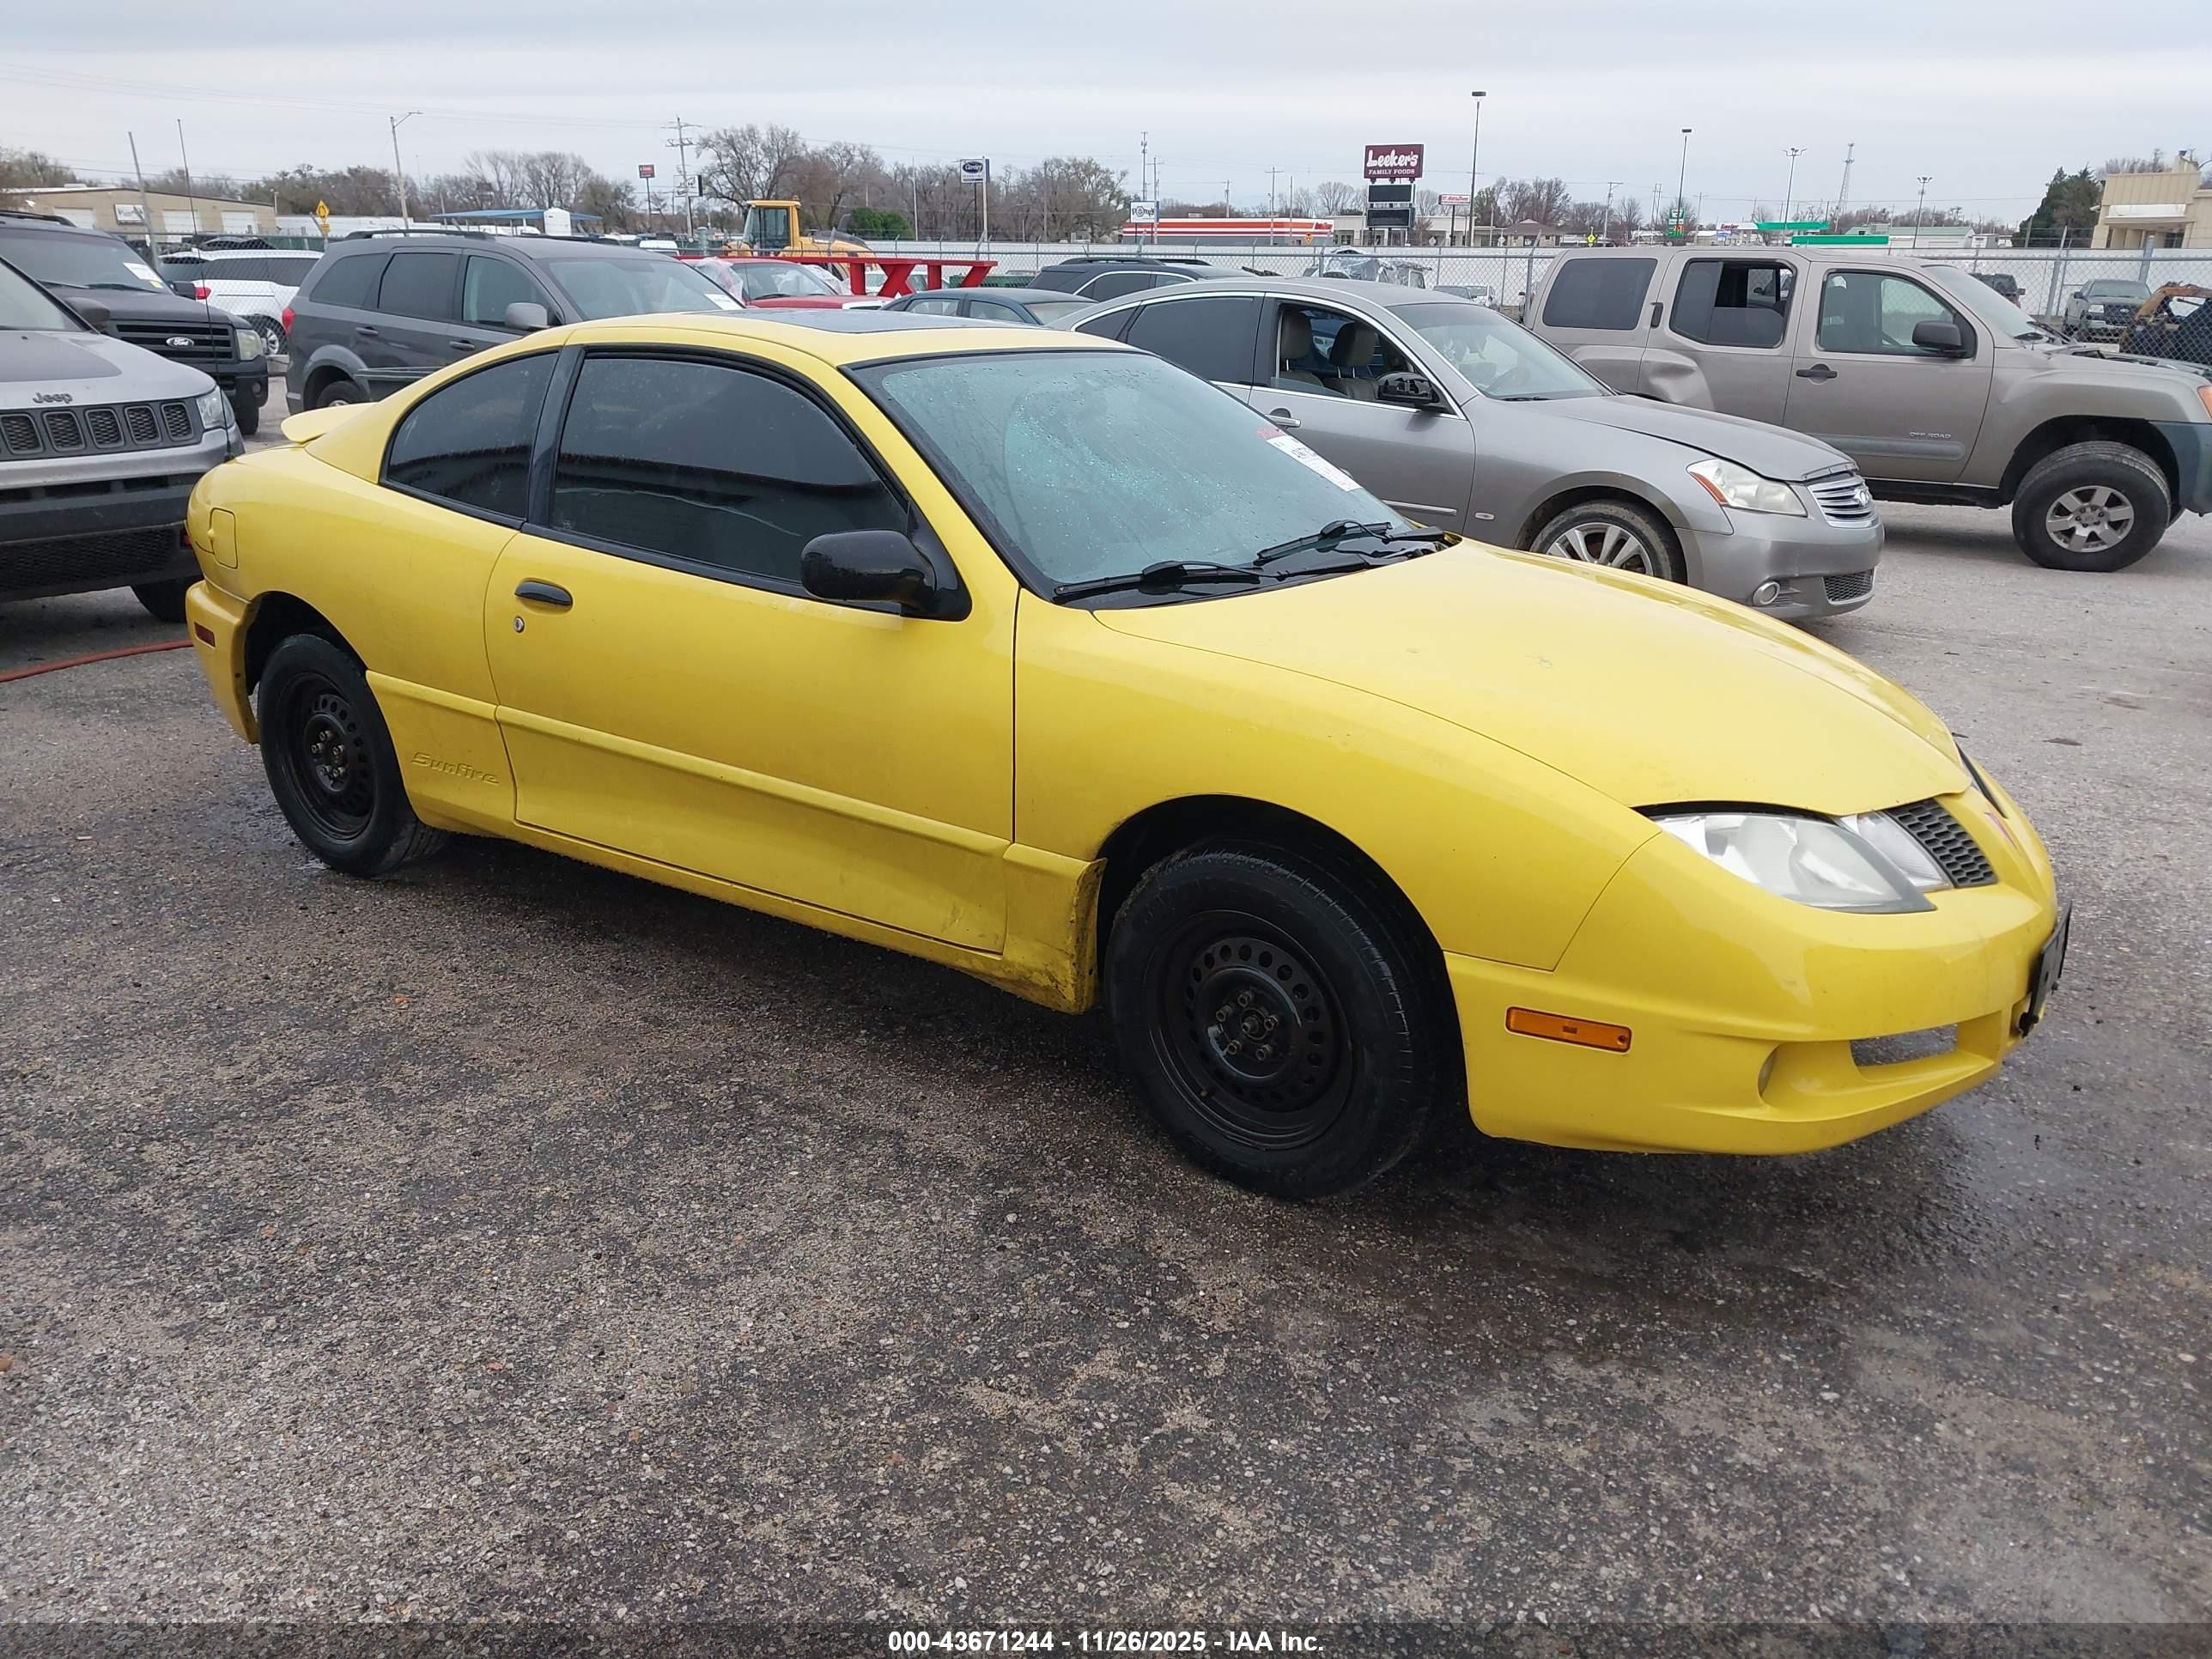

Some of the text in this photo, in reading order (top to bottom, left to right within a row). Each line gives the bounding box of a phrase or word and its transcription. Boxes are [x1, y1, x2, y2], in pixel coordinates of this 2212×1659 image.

[1366, 149, 1419, 167] Leeker's
[32, 392, 73, 404] Jeep
[411, 751, 500, 786] Sunfire
